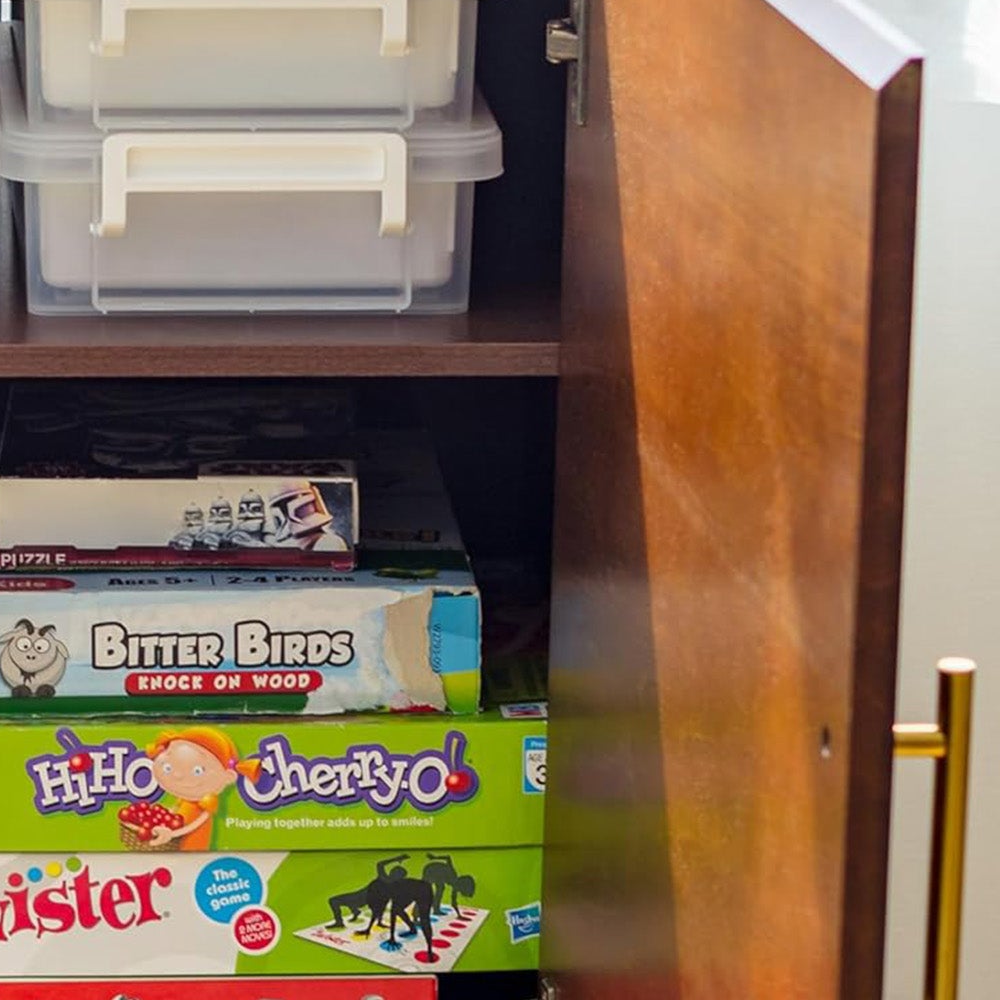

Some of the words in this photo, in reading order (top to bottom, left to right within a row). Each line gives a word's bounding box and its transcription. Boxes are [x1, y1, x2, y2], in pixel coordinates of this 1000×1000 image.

[137, 675, 204, 691] KNOCK
[213, 674, 241, 690] ON
[251, 673, 312, 689] WOOD
[226, 818, 271, 829] Playing
[274, 818, 324, 829] together
[327, 817, 355, 828] adds
[358, 818, 374, 829] up
[376, 817, 389, 827] to
[391, 816, 433, 827] smiles!
[212, 868, 238, 881] The
[206, 878, 250, 895] classic
[210, 893, 250, 911] game
